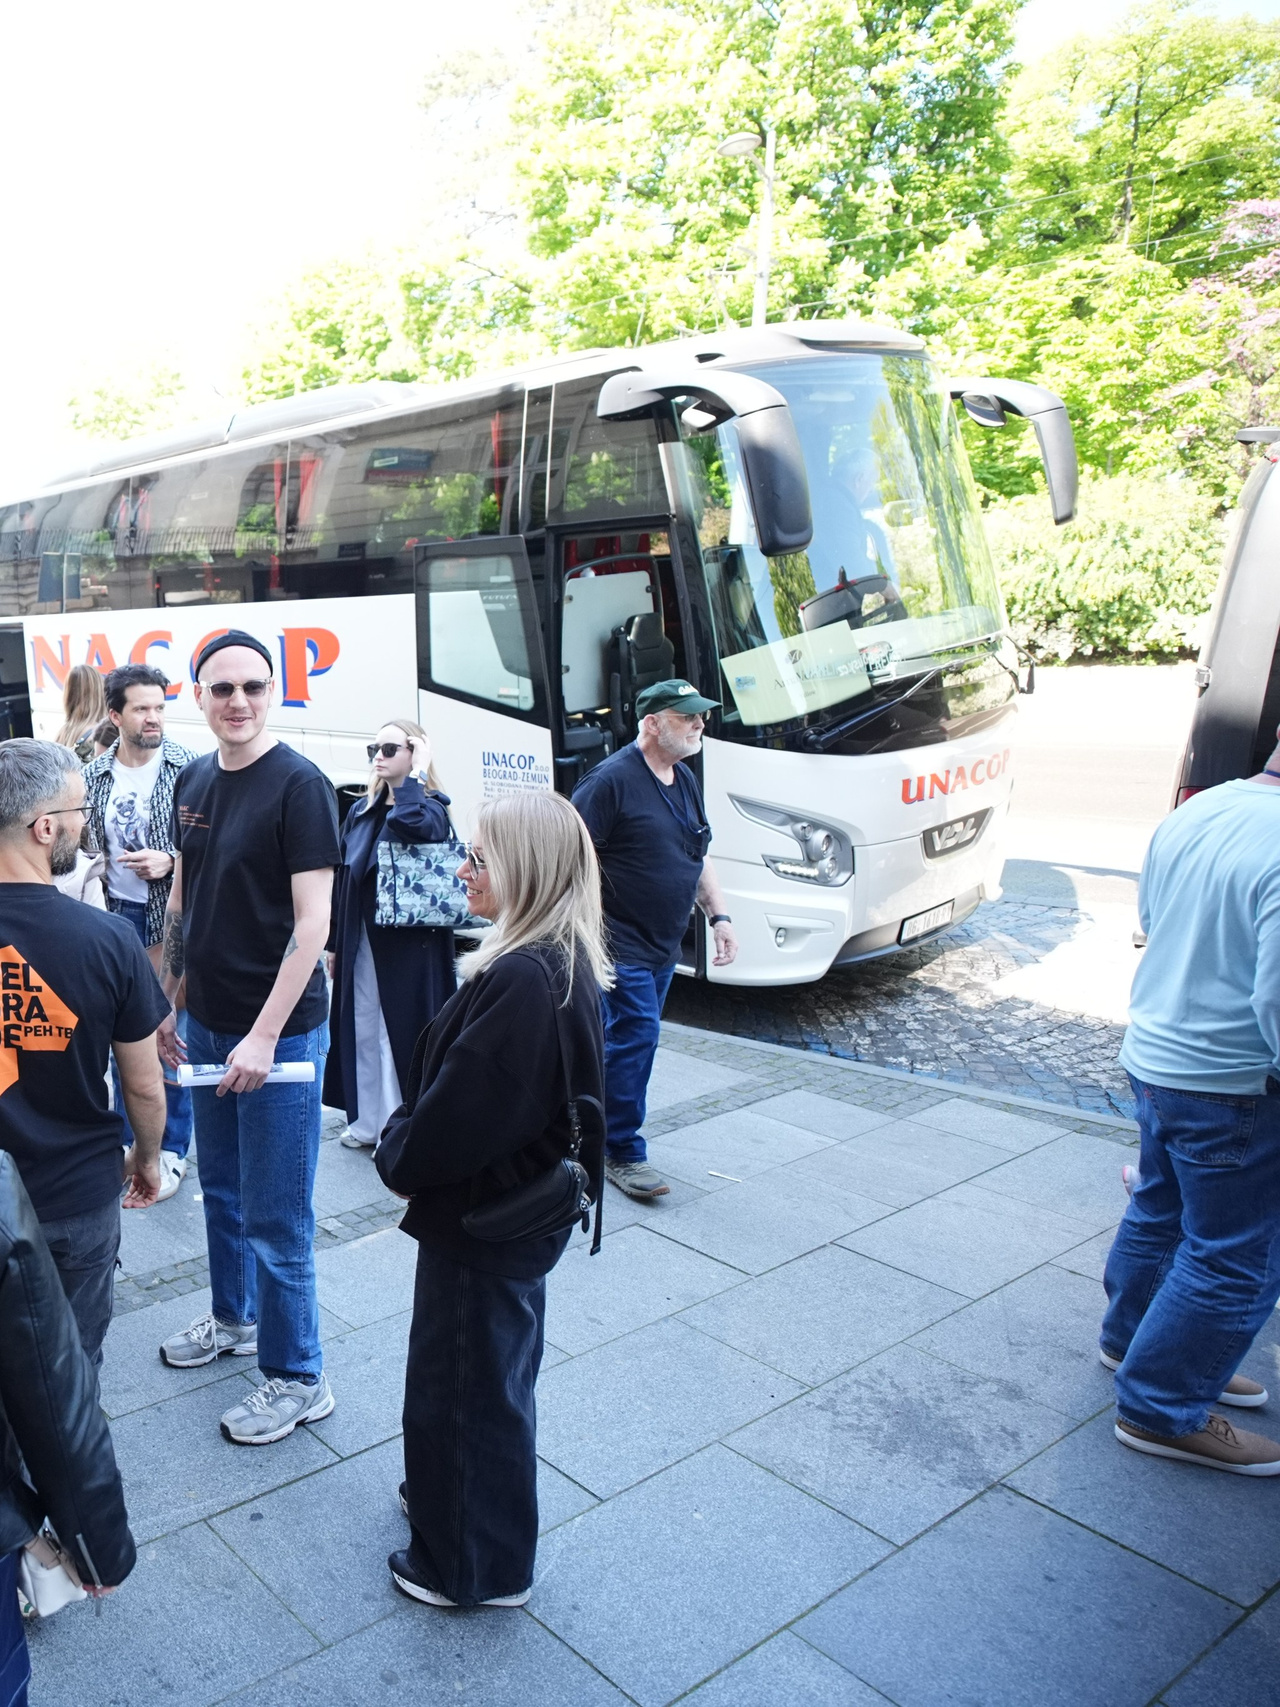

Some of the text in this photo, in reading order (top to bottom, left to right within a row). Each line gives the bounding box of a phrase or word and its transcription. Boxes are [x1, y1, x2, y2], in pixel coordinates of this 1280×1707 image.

[482, 751, 535, 770] UNACOP
[901, 748, 1010, 805] UNACOP
[931, 817, 977, 851] VDL
